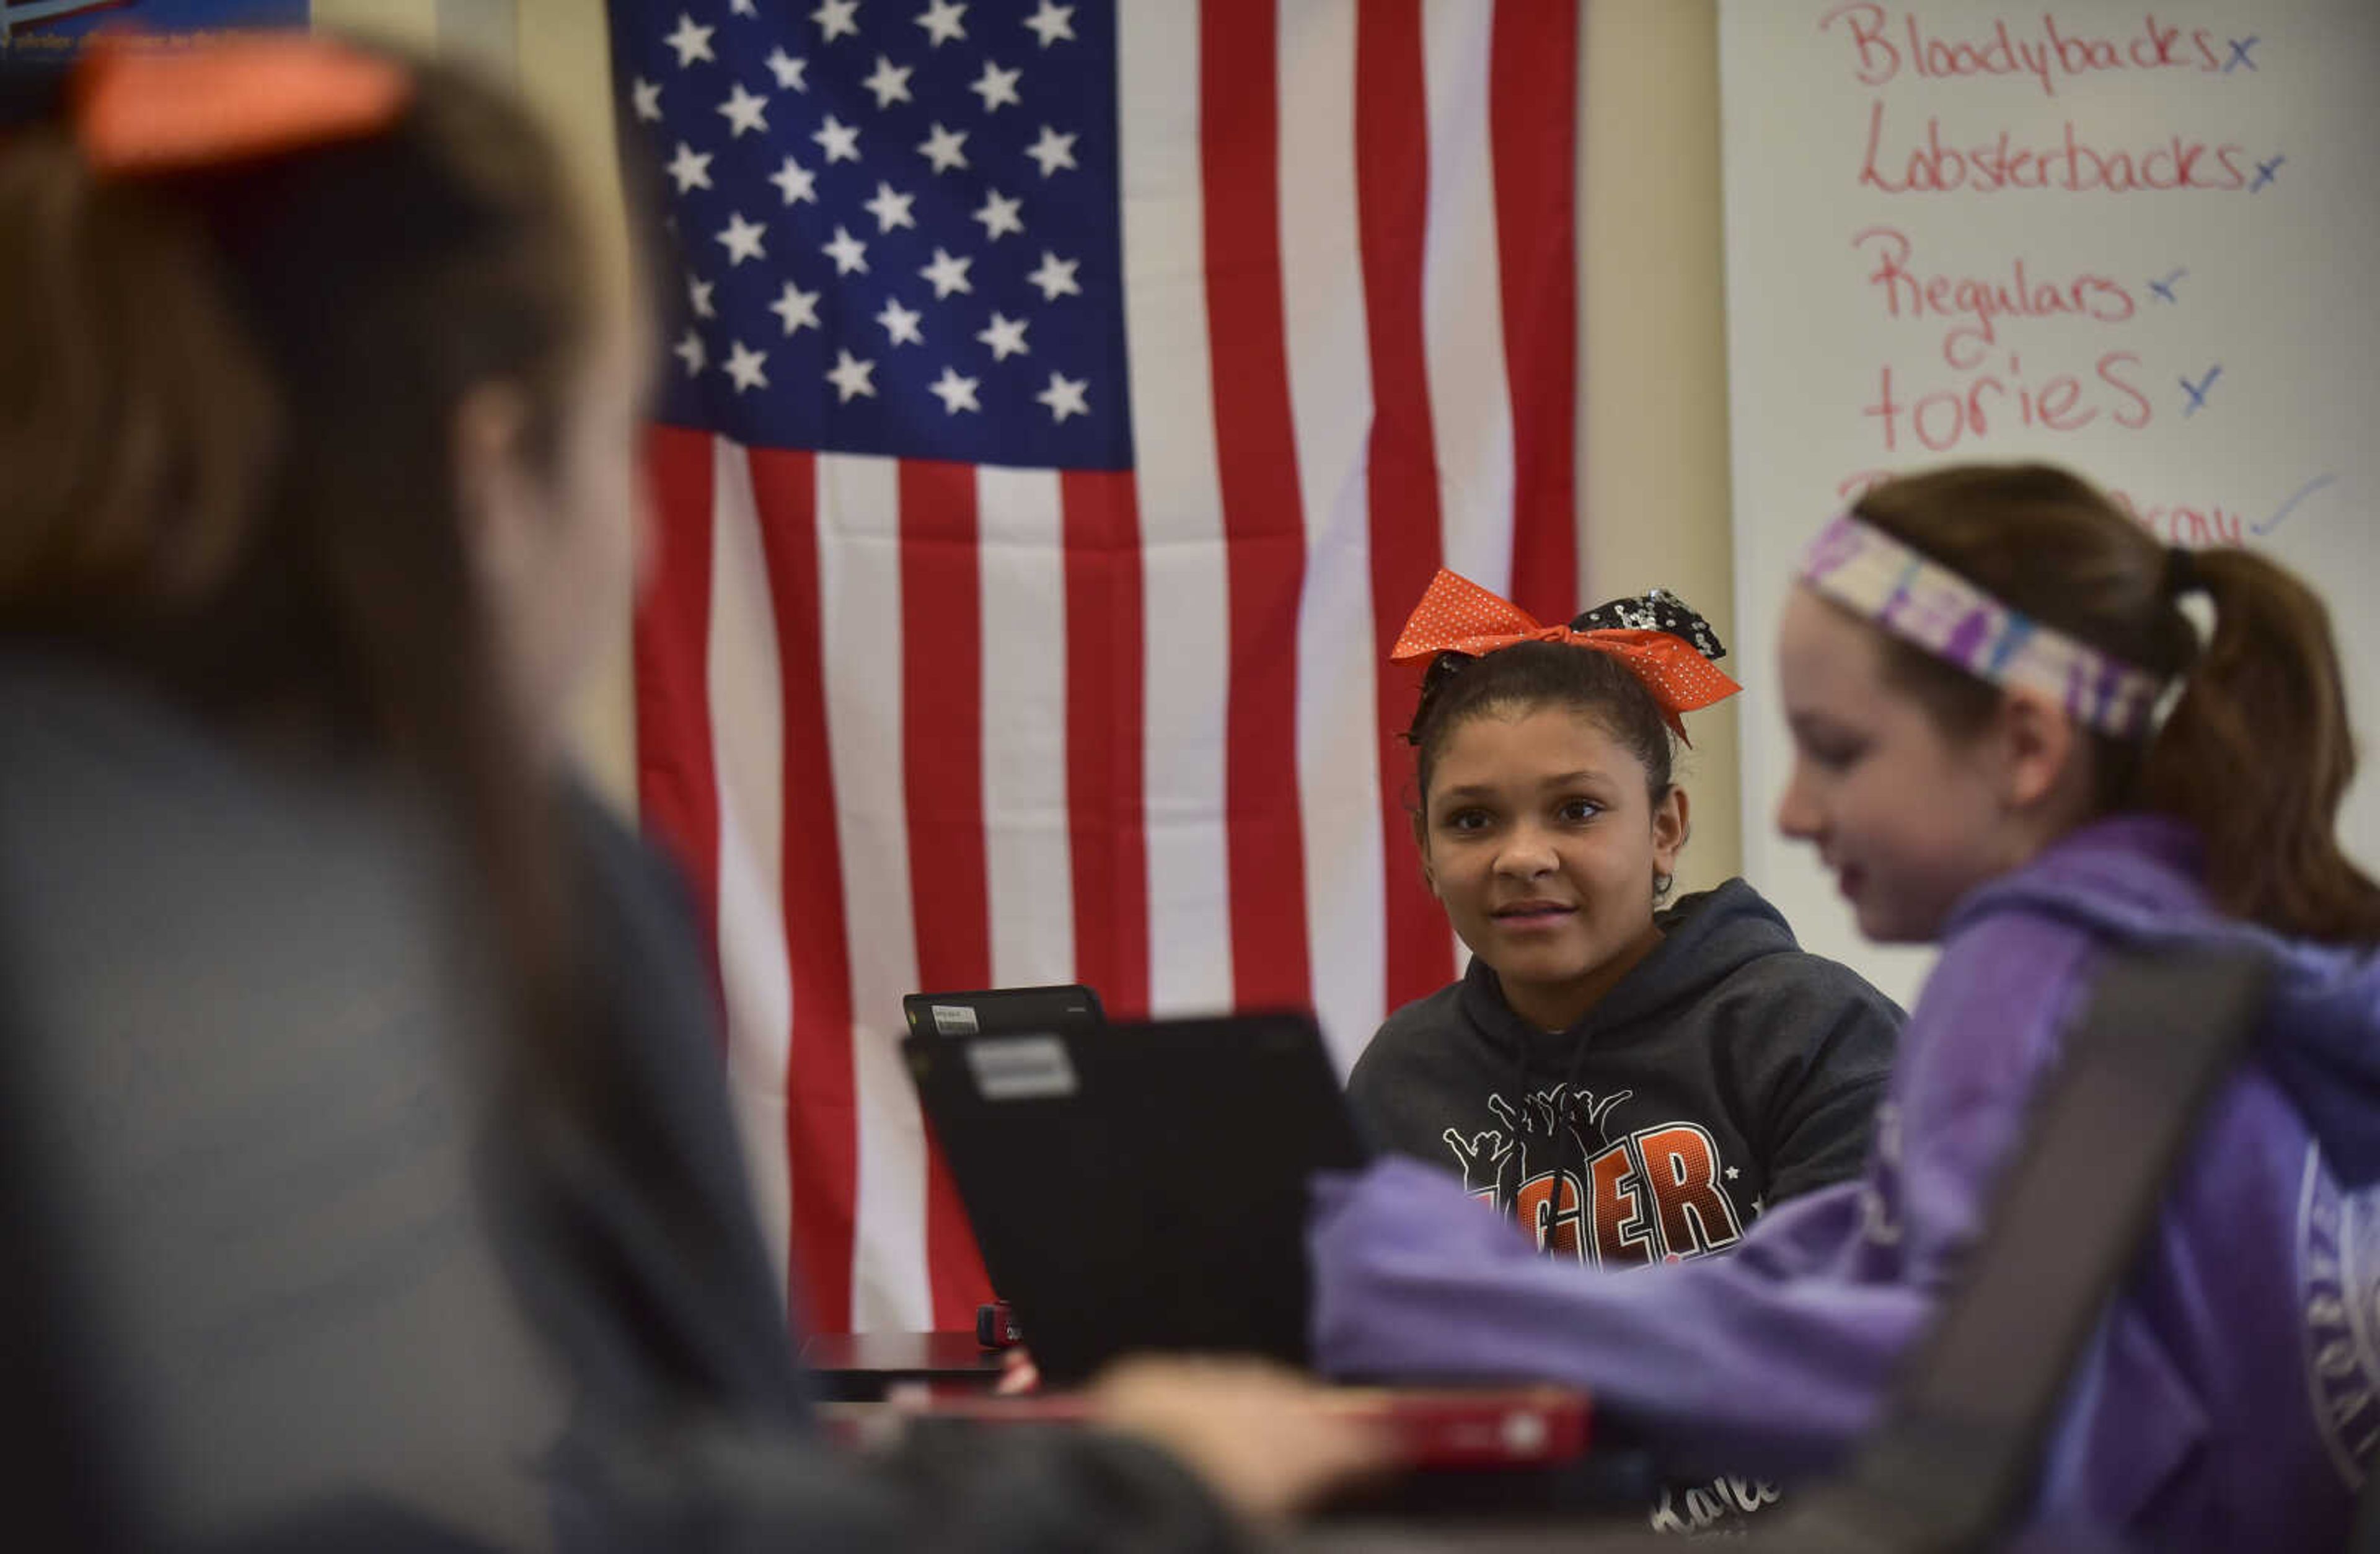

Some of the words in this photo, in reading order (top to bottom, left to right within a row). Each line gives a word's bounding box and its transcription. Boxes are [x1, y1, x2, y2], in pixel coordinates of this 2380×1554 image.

[1819, 2, 2221, 97] Bloodybacks
[1859, 101, 2245, 193] Lobsterbacks
[1853, 227, 2136, 370] Regulars
